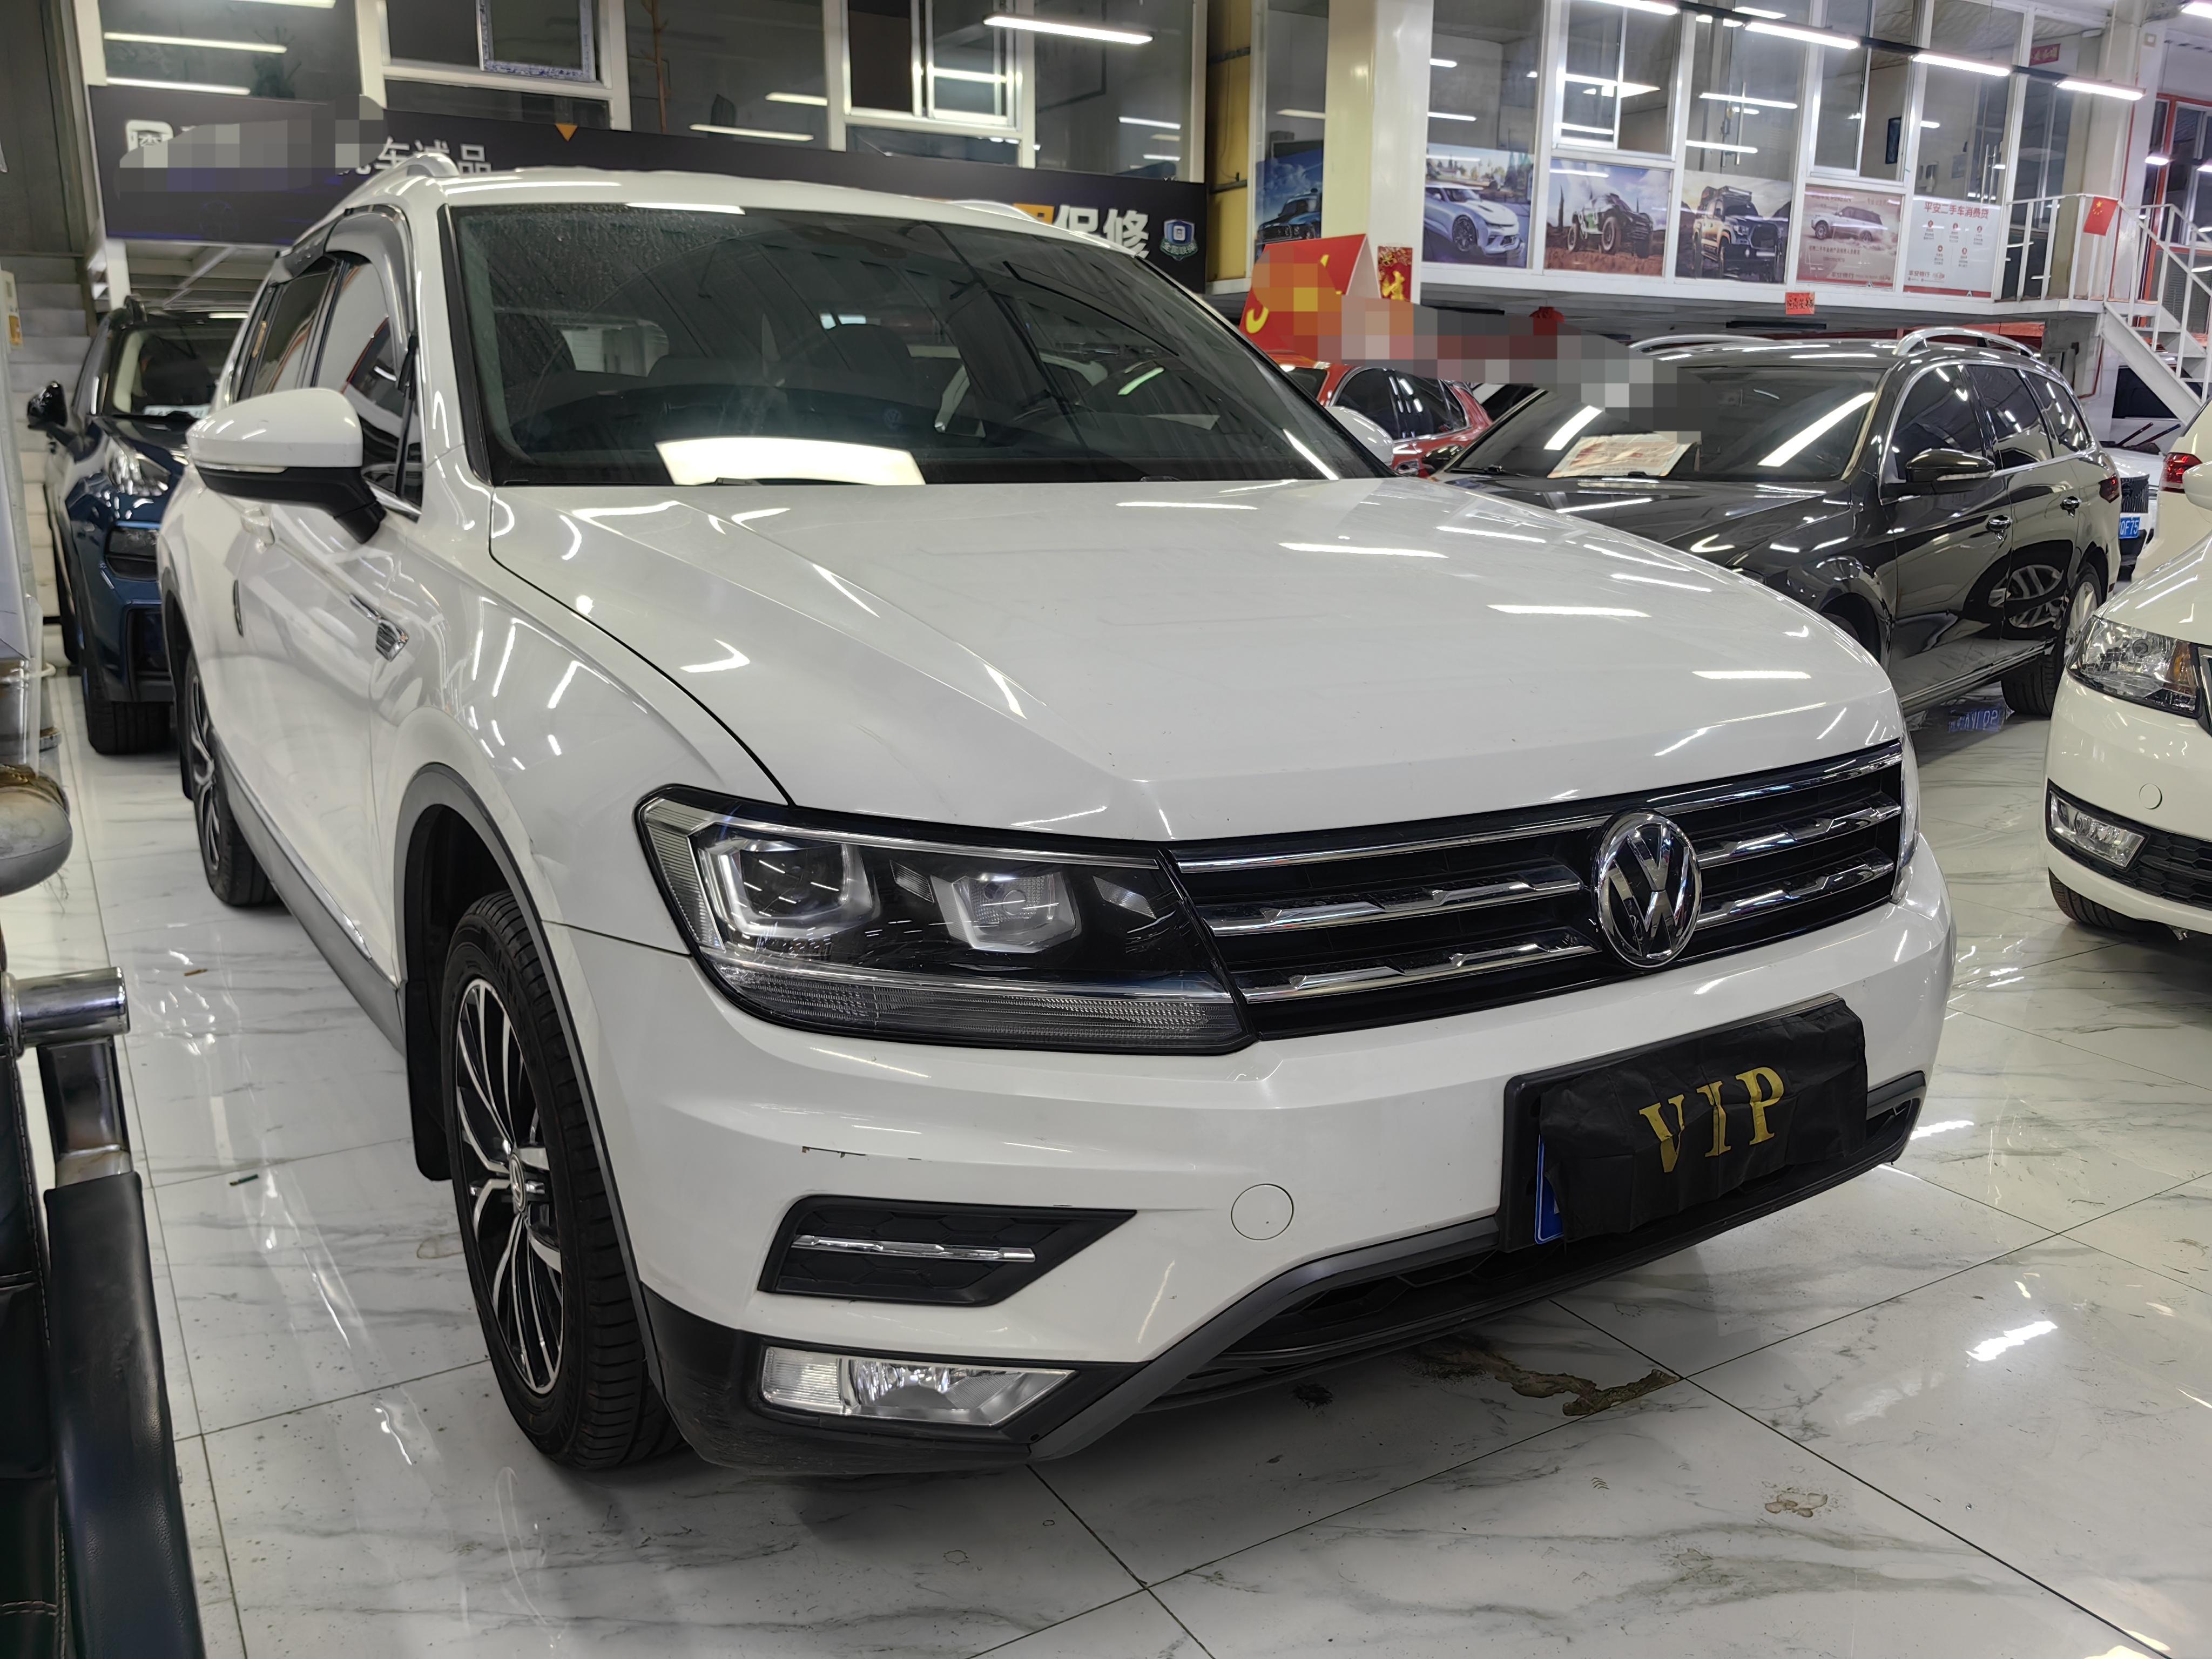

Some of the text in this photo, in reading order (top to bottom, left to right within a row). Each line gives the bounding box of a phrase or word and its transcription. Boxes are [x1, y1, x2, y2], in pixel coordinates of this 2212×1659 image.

[1924, 201, 1990, 220] 平安二手车消费贷
[1639, 1067, 1784, 1172] VIP
